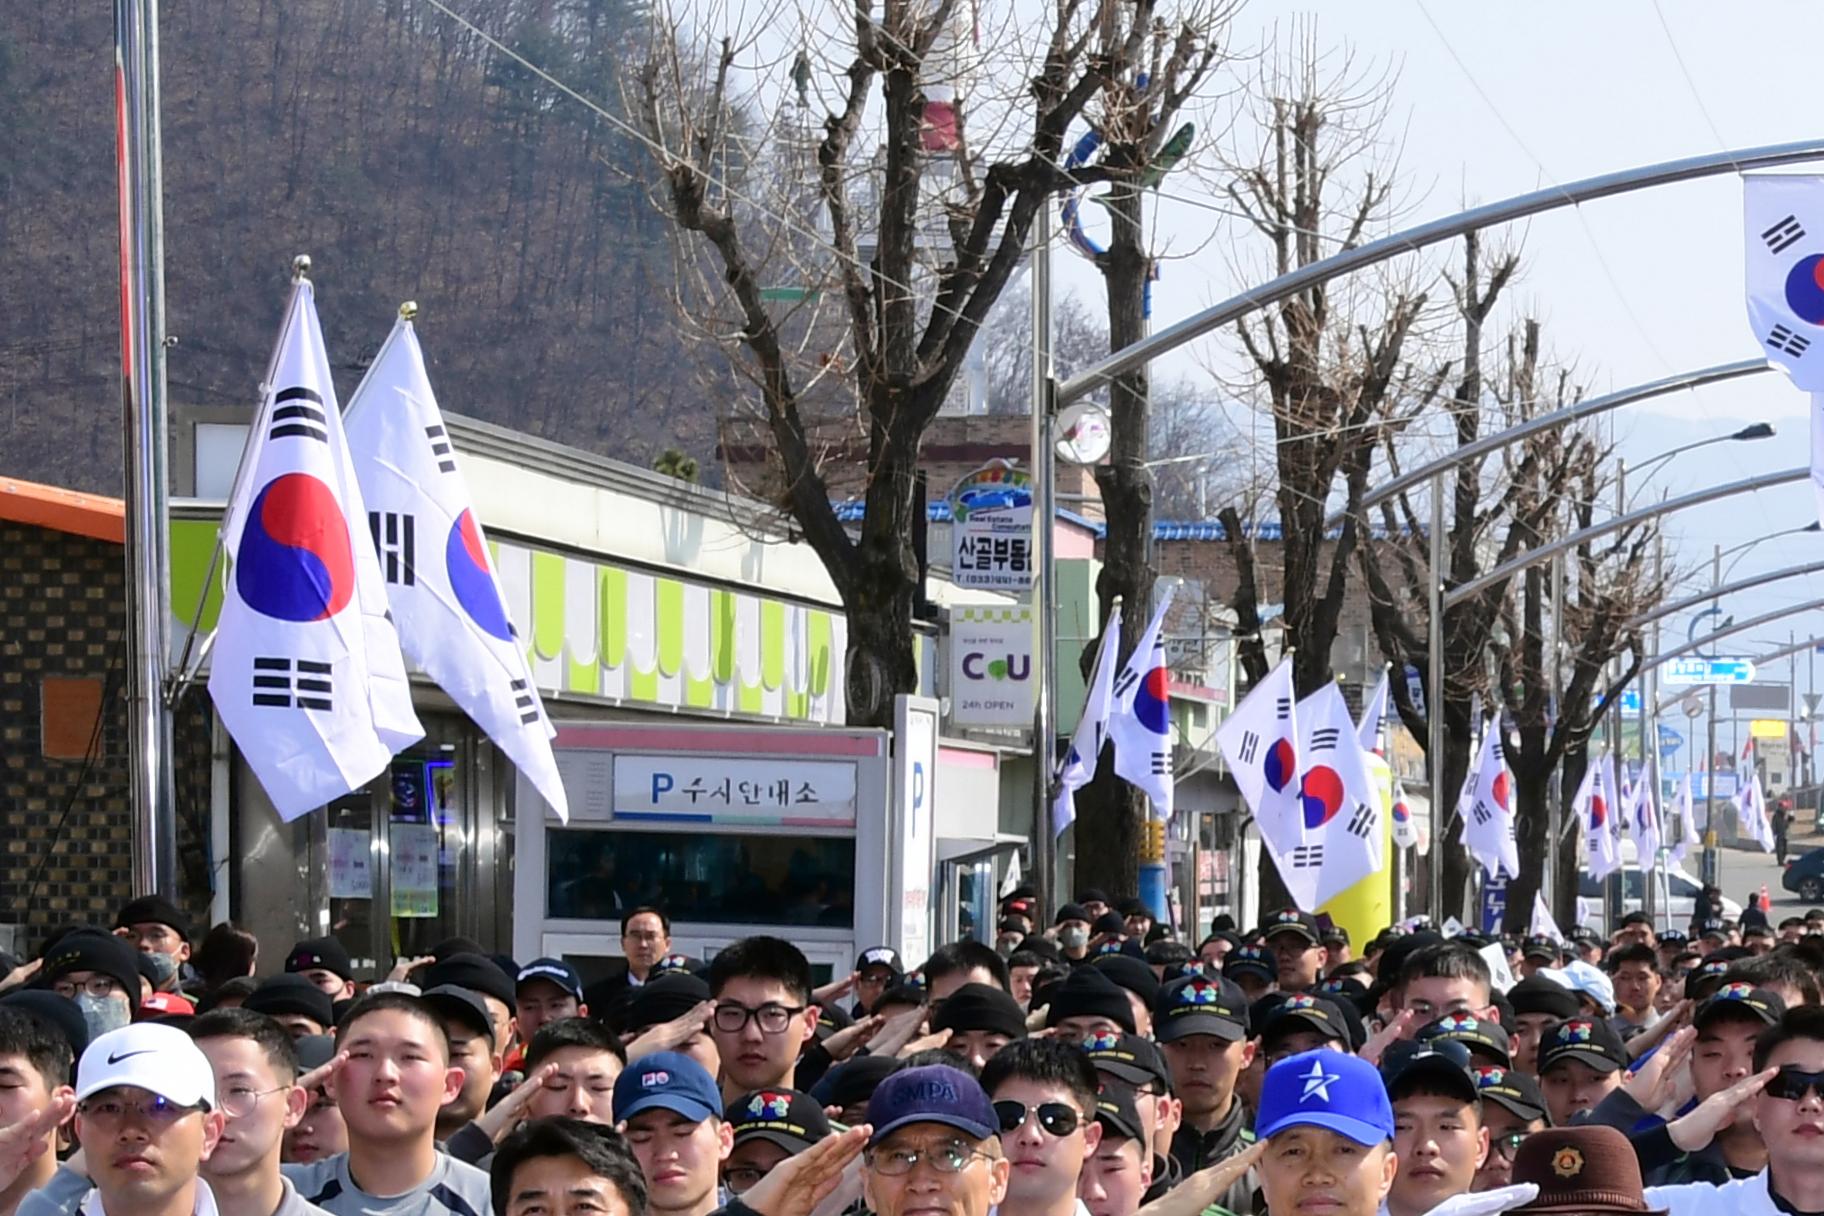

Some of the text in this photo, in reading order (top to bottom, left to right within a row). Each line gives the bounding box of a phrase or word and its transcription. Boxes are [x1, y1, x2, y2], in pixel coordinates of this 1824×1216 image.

[962, 701, 1014, 710] 24h OPEN
[651, 773, 674, 804] P
